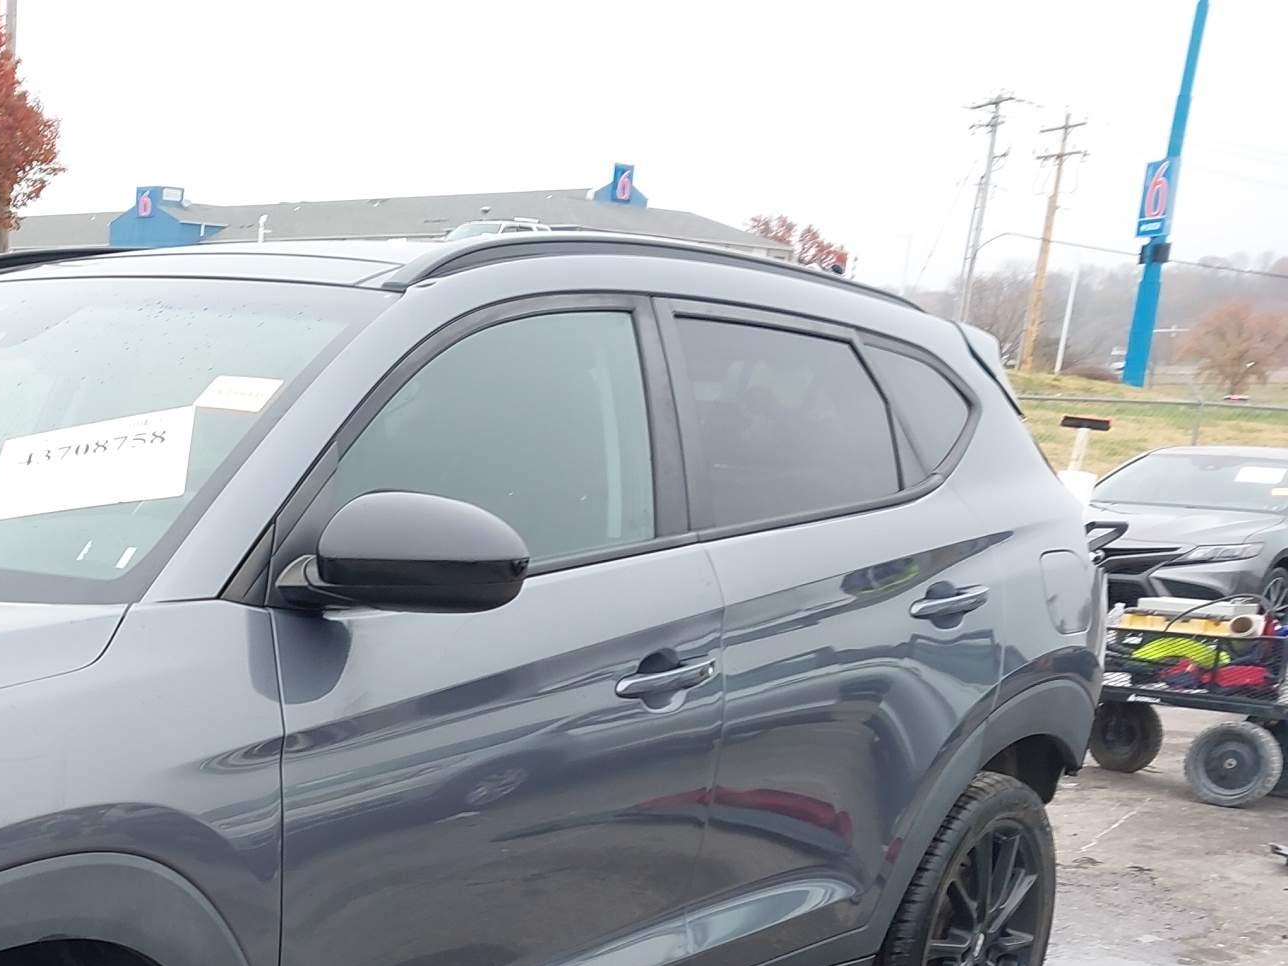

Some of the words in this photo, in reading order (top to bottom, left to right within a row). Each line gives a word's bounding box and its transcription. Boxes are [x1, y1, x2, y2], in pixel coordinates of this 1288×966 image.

[617, 169, 633, 200] 6
[1146, 160, 1169, 217] 6
[138, 190, 152, 217] 6
